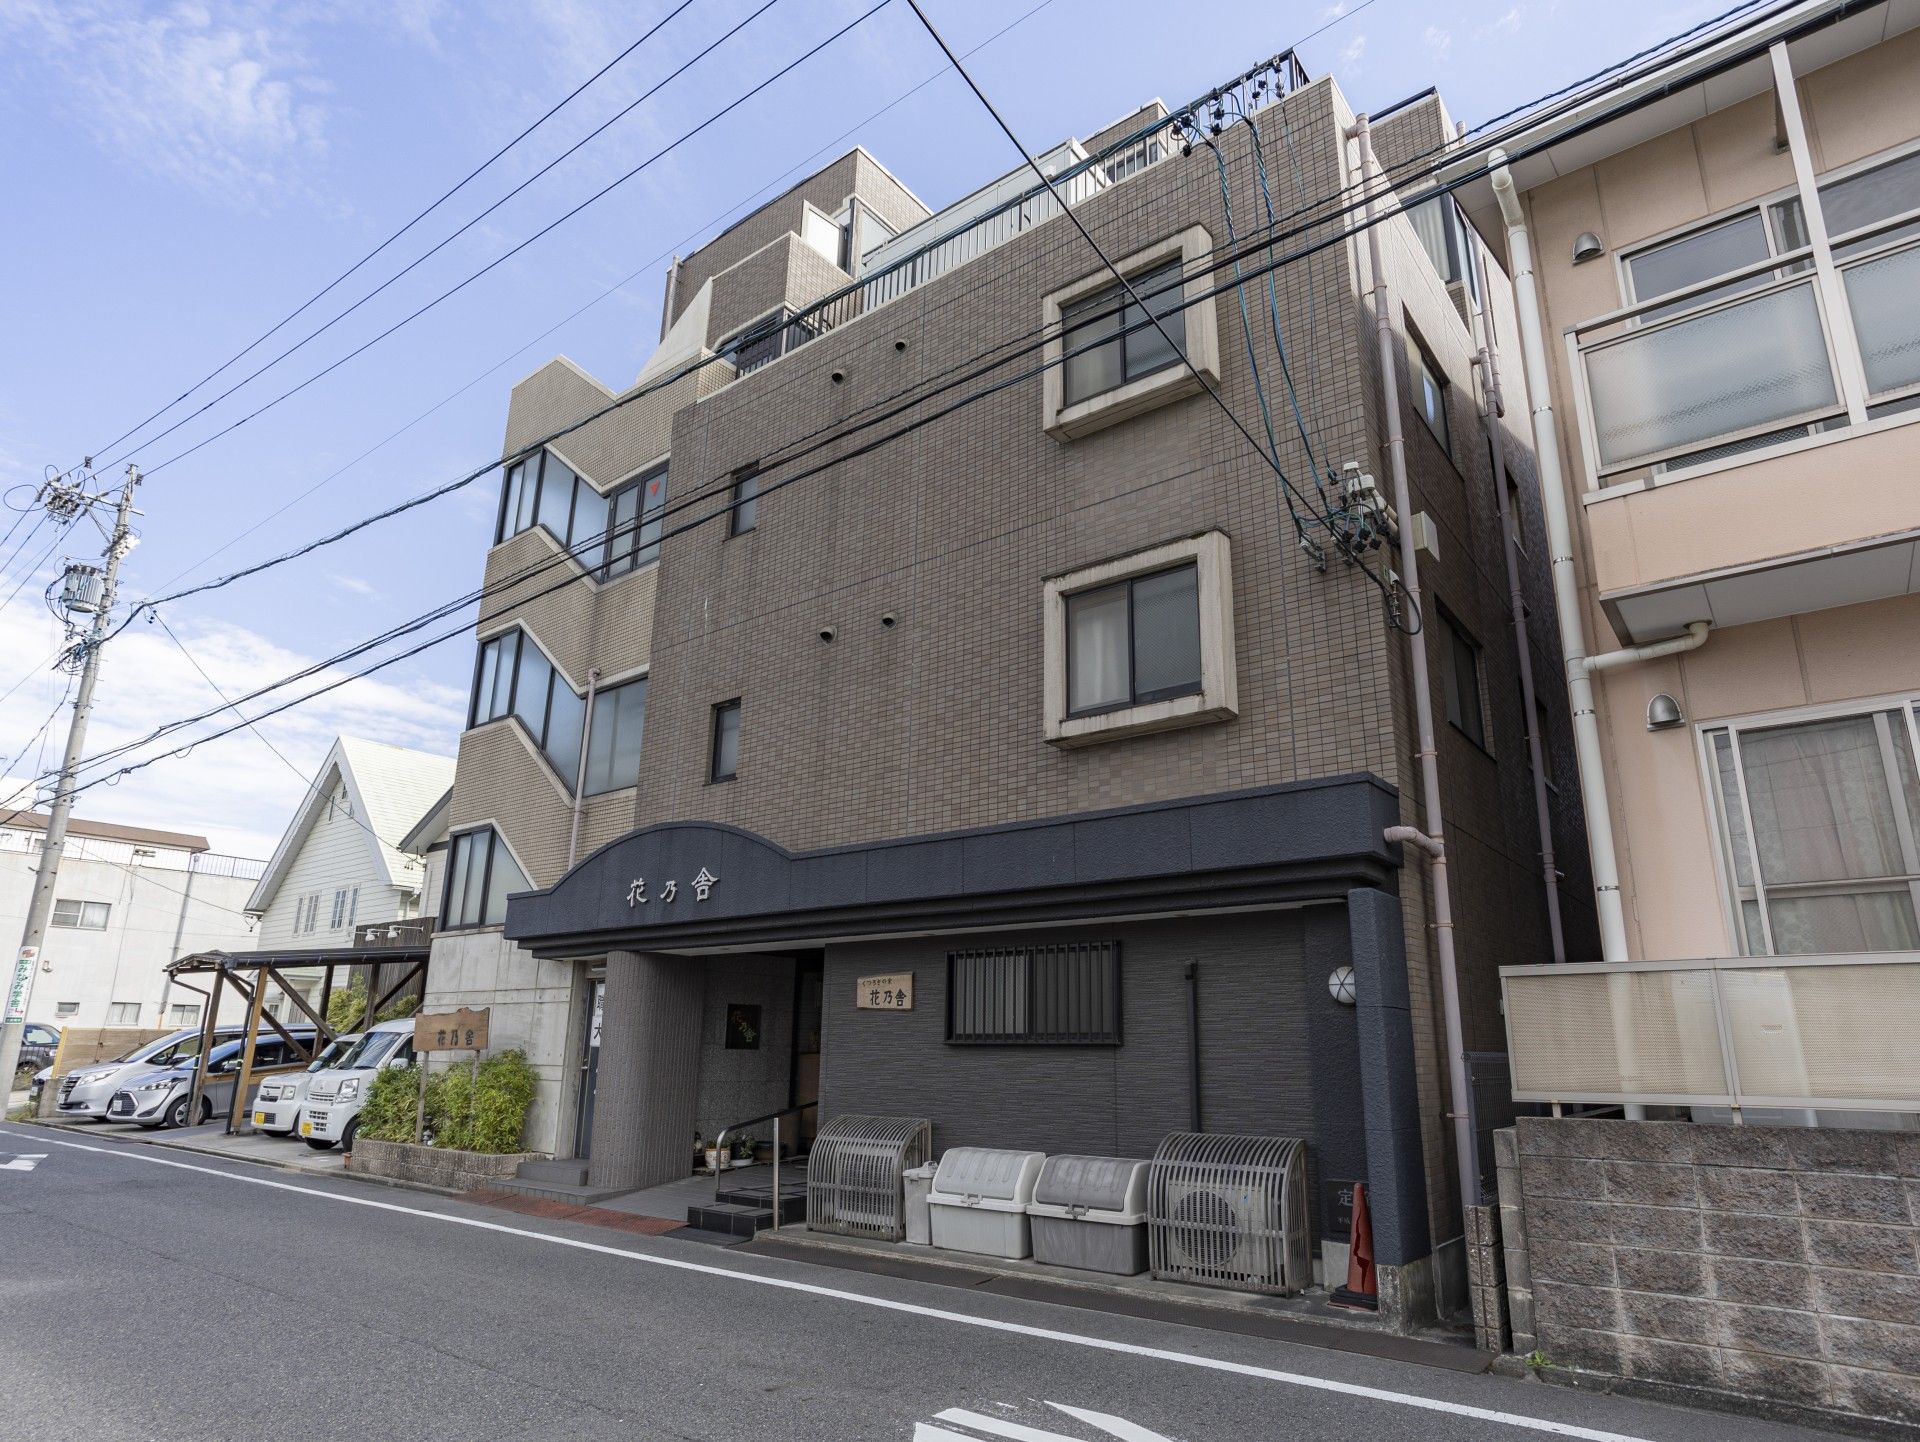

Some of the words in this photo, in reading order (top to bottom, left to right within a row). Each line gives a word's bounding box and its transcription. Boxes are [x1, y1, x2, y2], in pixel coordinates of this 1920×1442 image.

[626, 866, 719, 908] 花乃舎
[869, 987, 907, 1007] 花乃舎
